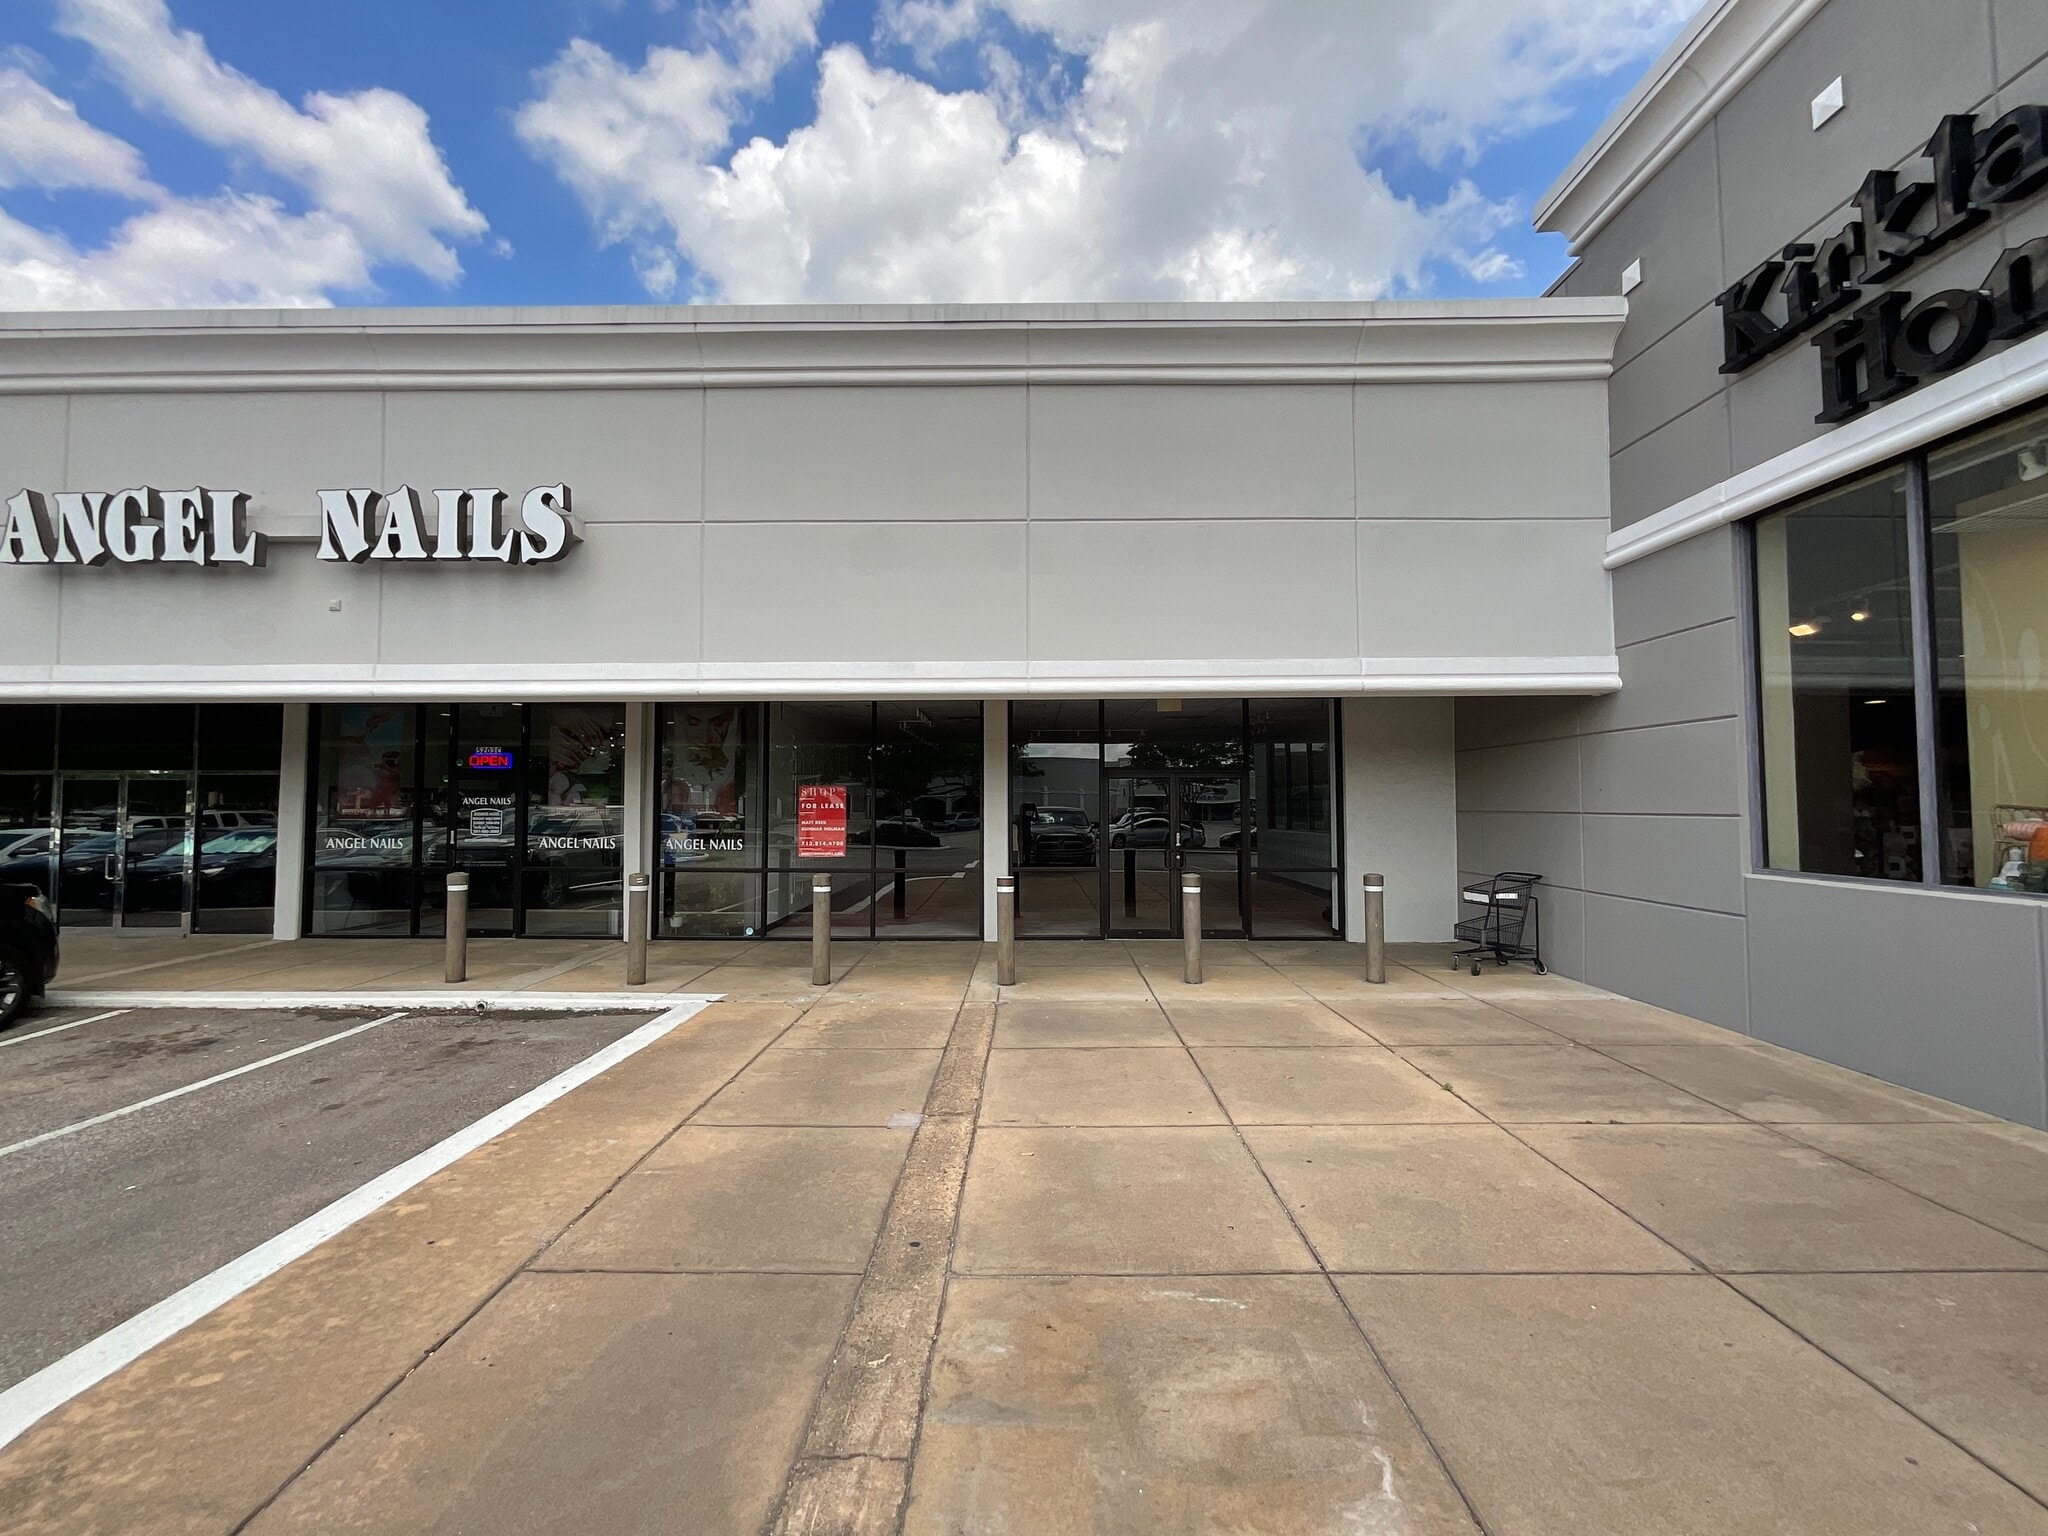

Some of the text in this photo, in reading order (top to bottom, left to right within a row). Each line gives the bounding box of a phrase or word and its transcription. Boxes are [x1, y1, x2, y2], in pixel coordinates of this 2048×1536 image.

[0, 483, 572, 567] ANGEL NAILS
[469, 755, 509, 766] OPEN
[801, 788, 836, 796] SHOP
[462, 797, 511, 805] ANGEL NAILS
[325, 838, 404, 849] ANGEL NAILS
[539, 837, 616, 849] ANGEL NAILS
[666, 838, 743, 850] ANGEL NAILS
